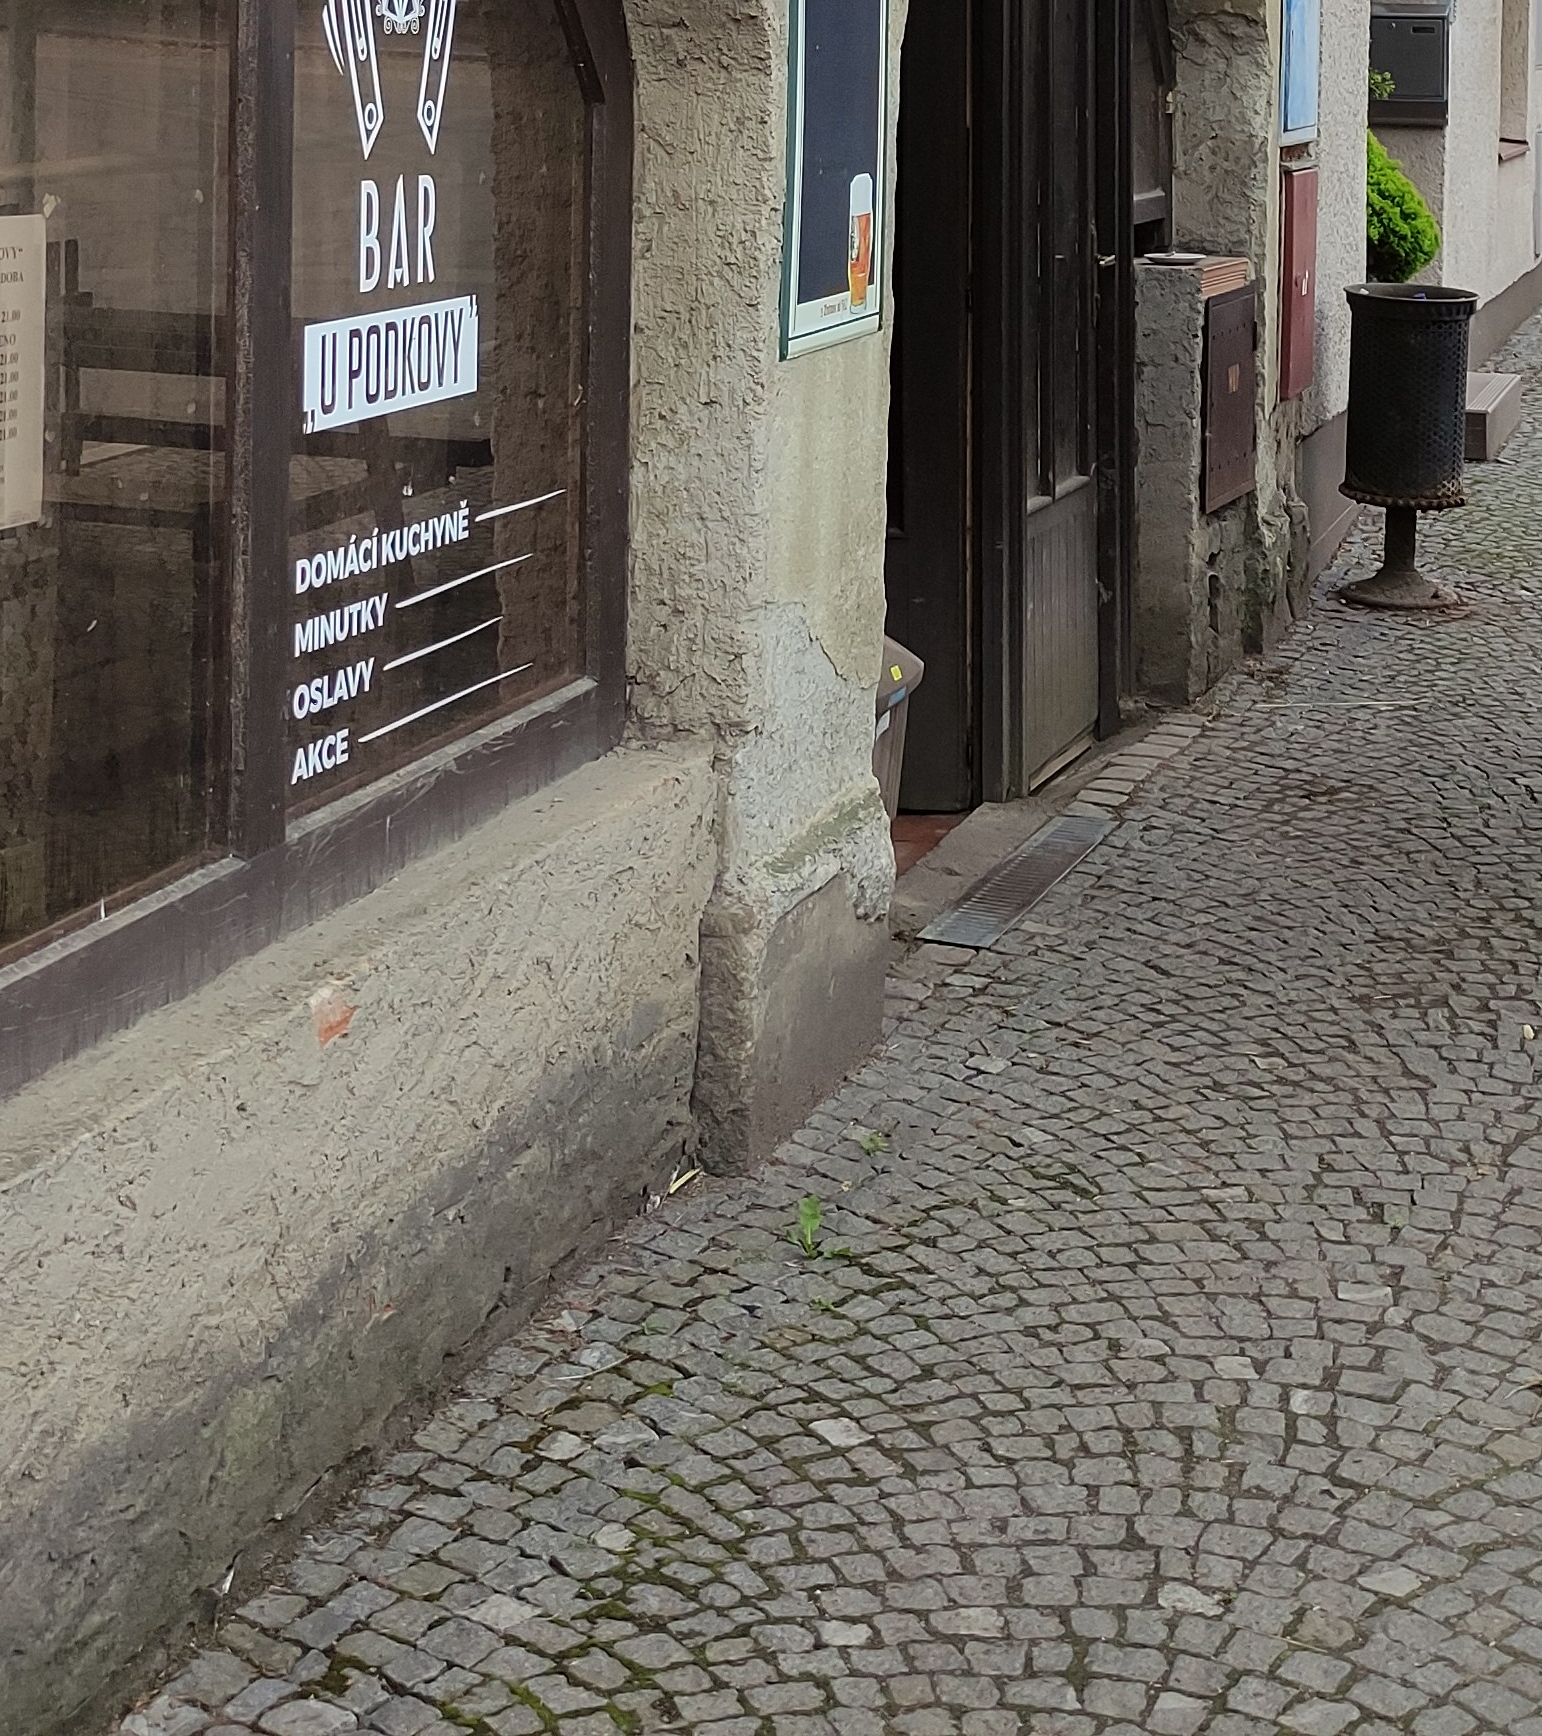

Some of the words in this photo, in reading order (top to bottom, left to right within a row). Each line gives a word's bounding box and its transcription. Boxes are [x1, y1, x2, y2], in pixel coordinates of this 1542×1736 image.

[360, 174, 436, 293] BAR
[0, 271, 24, 284] DOBA
[296, 527, 378, 595] DOMÁCÍ
[381, 499, 470, 566] KUCHYNĚ
[294, 593, 389, 657] MINUTKY
[292, 657, 375, 719] OSLAVY
[290, 728, 349, 785] AKCE
